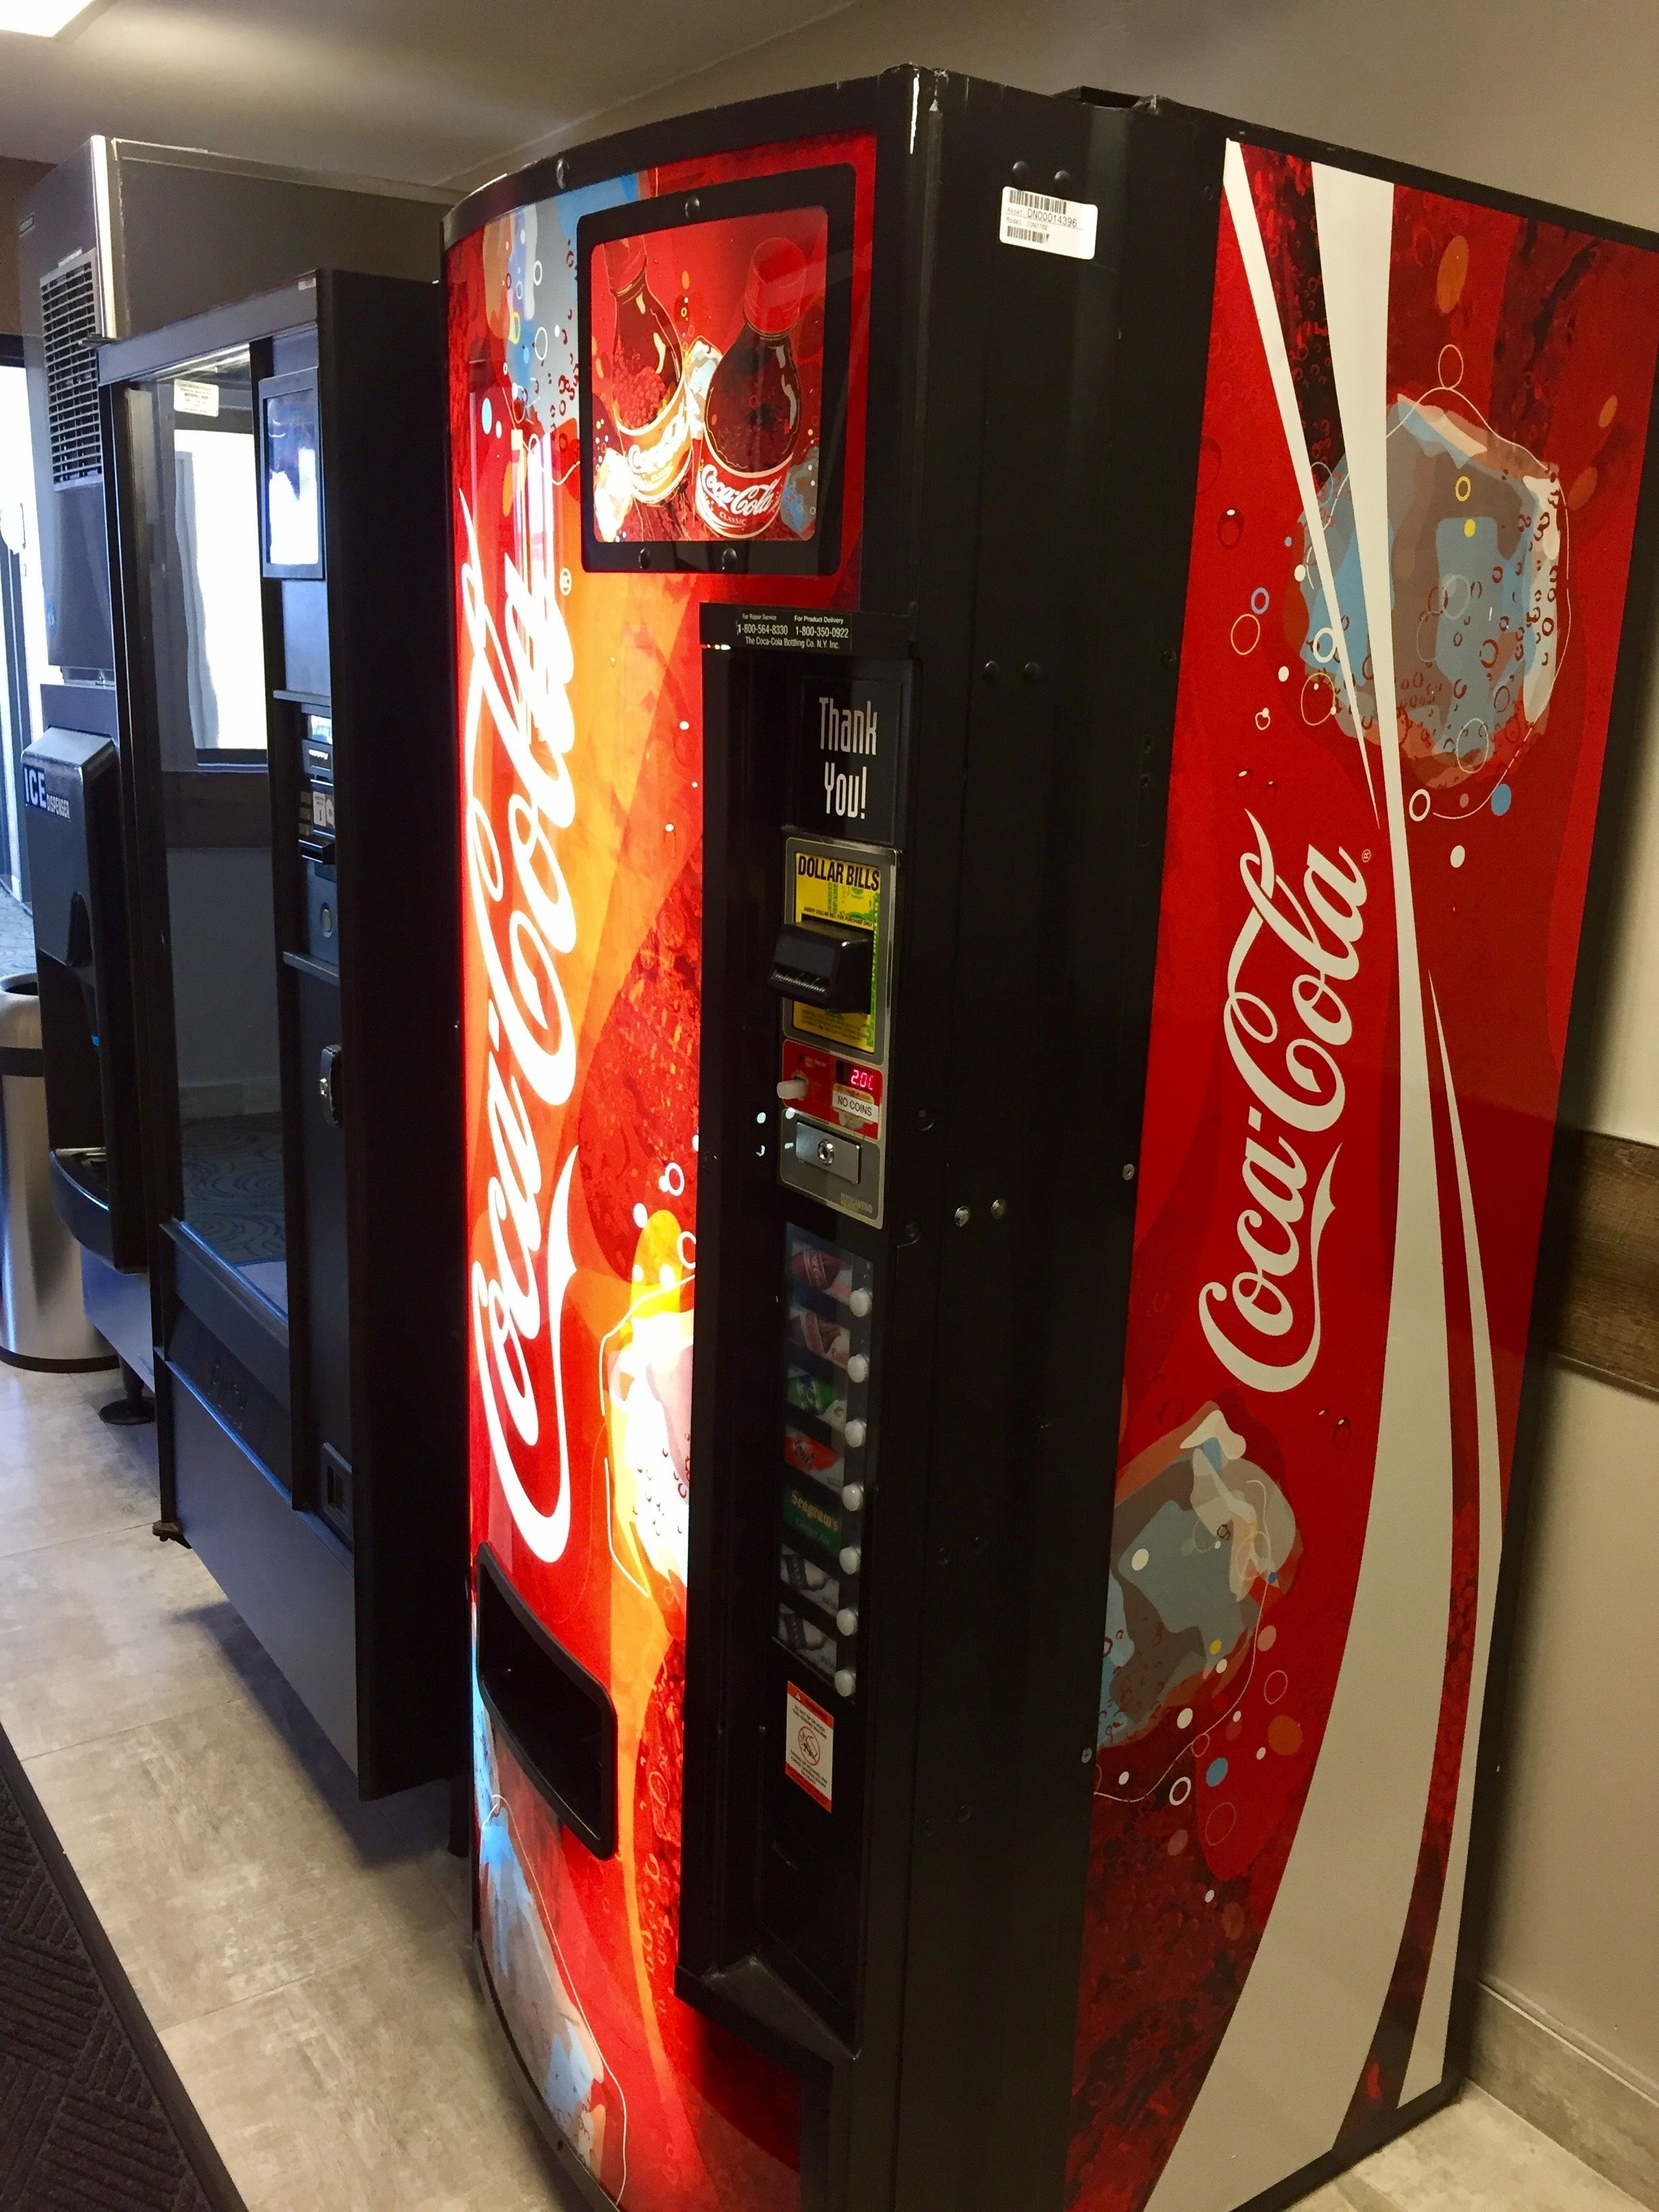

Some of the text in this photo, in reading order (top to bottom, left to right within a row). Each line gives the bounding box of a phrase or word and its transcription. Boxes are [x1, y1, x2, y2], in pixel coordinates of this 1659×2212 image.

[1027, 208, 1078, 228] DN00014396
[701, 464, 781, 516] Coca-Cola
[719, 511, 747, 526] CLASSIC
[737, 623, 788, 635] 1-800-564-8330
[795, 626, 849, 638] 1-800-350-0922
[823, 616, 844, 625] Delivery
[745, 636, 755, 644] The
[756, 636, 783, 646] Coca-Cola
[784, 638, 805, 649] Bottling
[806, 638, 815, 648] Co.
[819, 697, 878, 756] Thank
[24, 767, 47, 808] ICE
[824, 761, 867, 819] You!
[798, 855, 880, 892] DOLLAR BILLS
[455, 487, 578, 1563] Coca-Cola
[838, 1095, 873, 1117] NO COINS
[1198, 808, 1367, 1393] Coca-Cola
[792, 1489, 839, 1532] Seagram's
